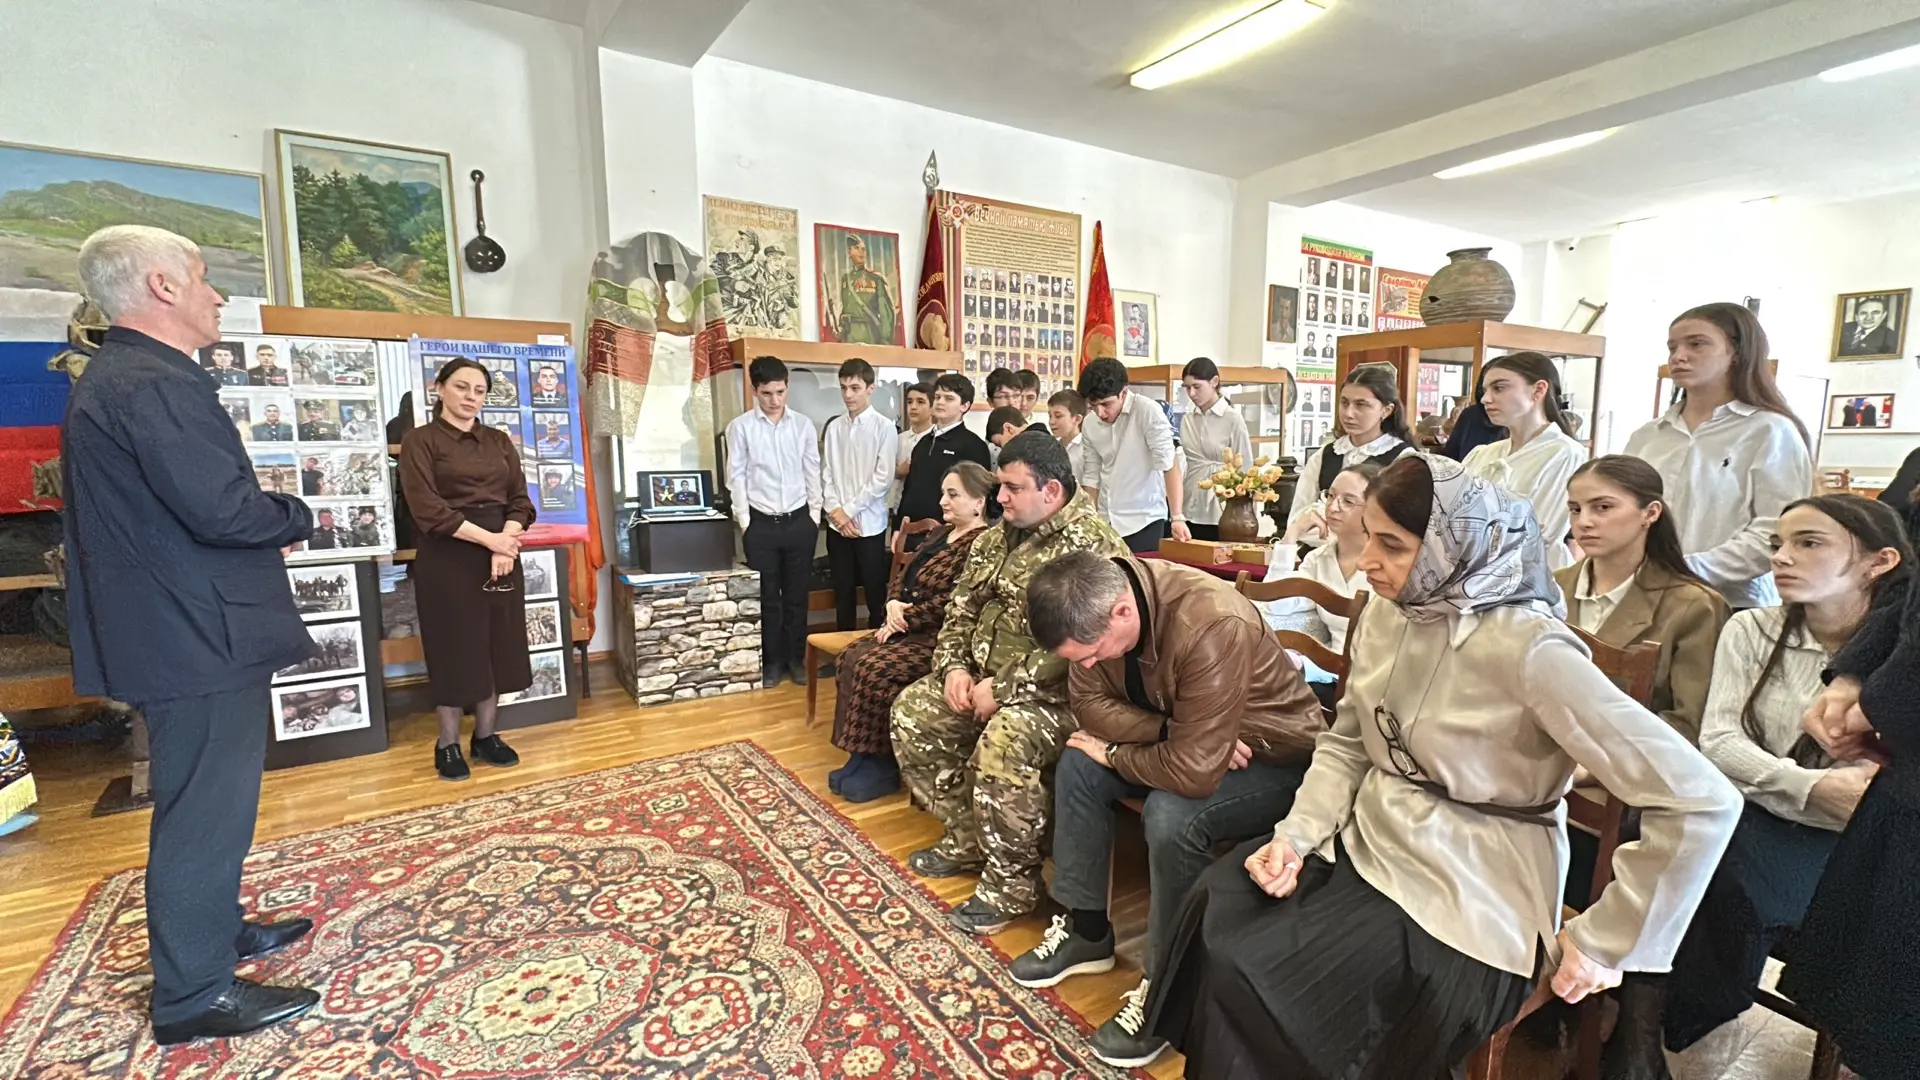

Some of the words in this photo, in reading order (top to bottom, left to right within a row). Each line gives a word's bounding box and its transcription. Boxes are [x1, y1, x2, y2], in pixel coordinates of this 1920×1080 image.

[420, 341, 458, 352] ГЕРОИ
[461, 344, 511, 355] НАШЕГО
[514, 346, 566, 358] ВРЕМЕНИ
